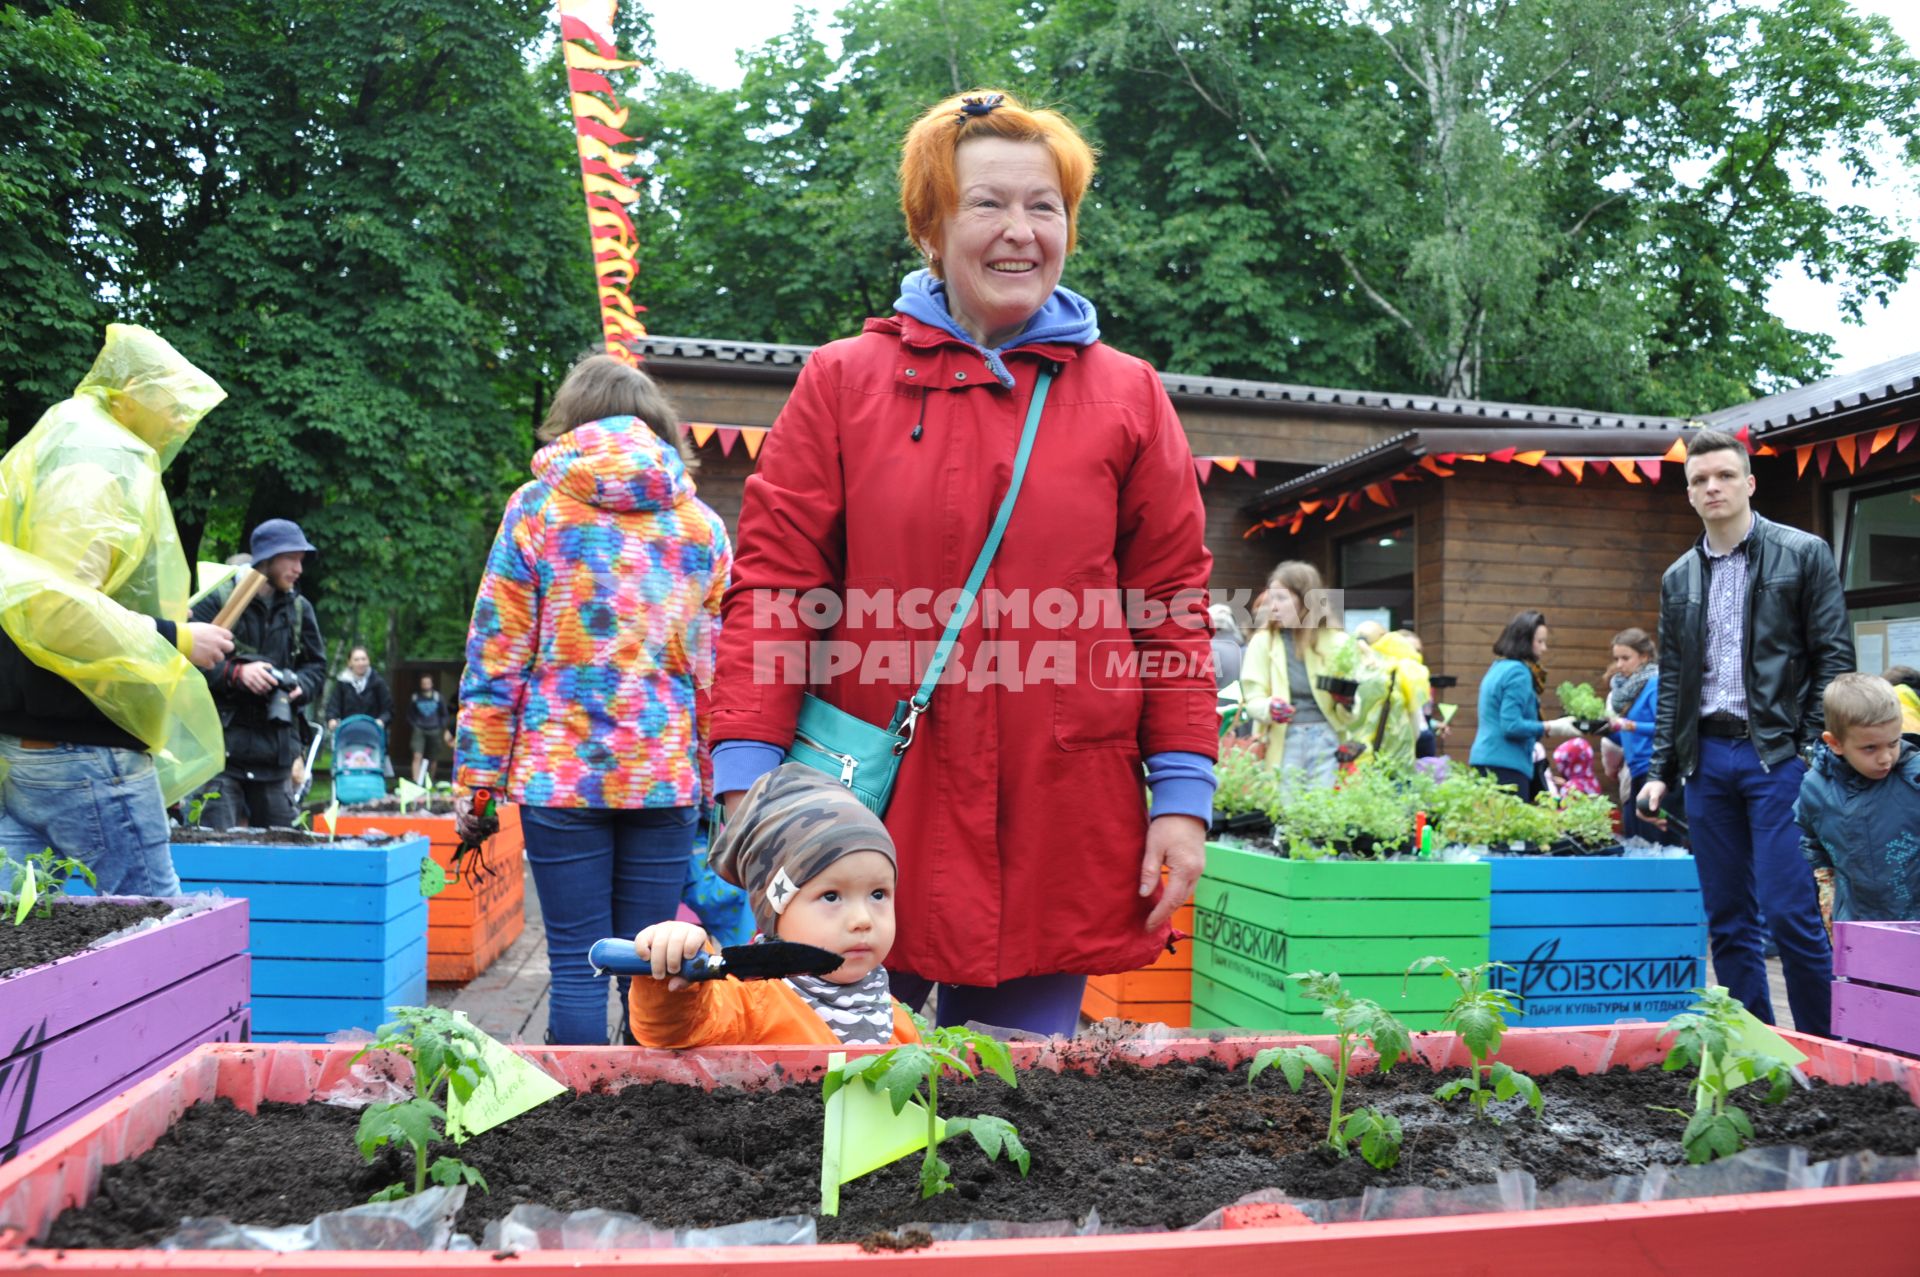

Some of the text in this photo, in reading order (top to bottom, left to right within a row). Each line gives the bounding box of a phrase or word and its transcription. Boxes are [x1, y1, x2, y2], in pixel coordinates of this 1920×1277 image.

[1529, 1004, 1562, 1015] ПАРК
[1566, 1002, 1629, 1014] КУЛЬТУРЫ
[1633, 1002, 1641, 1012] И
